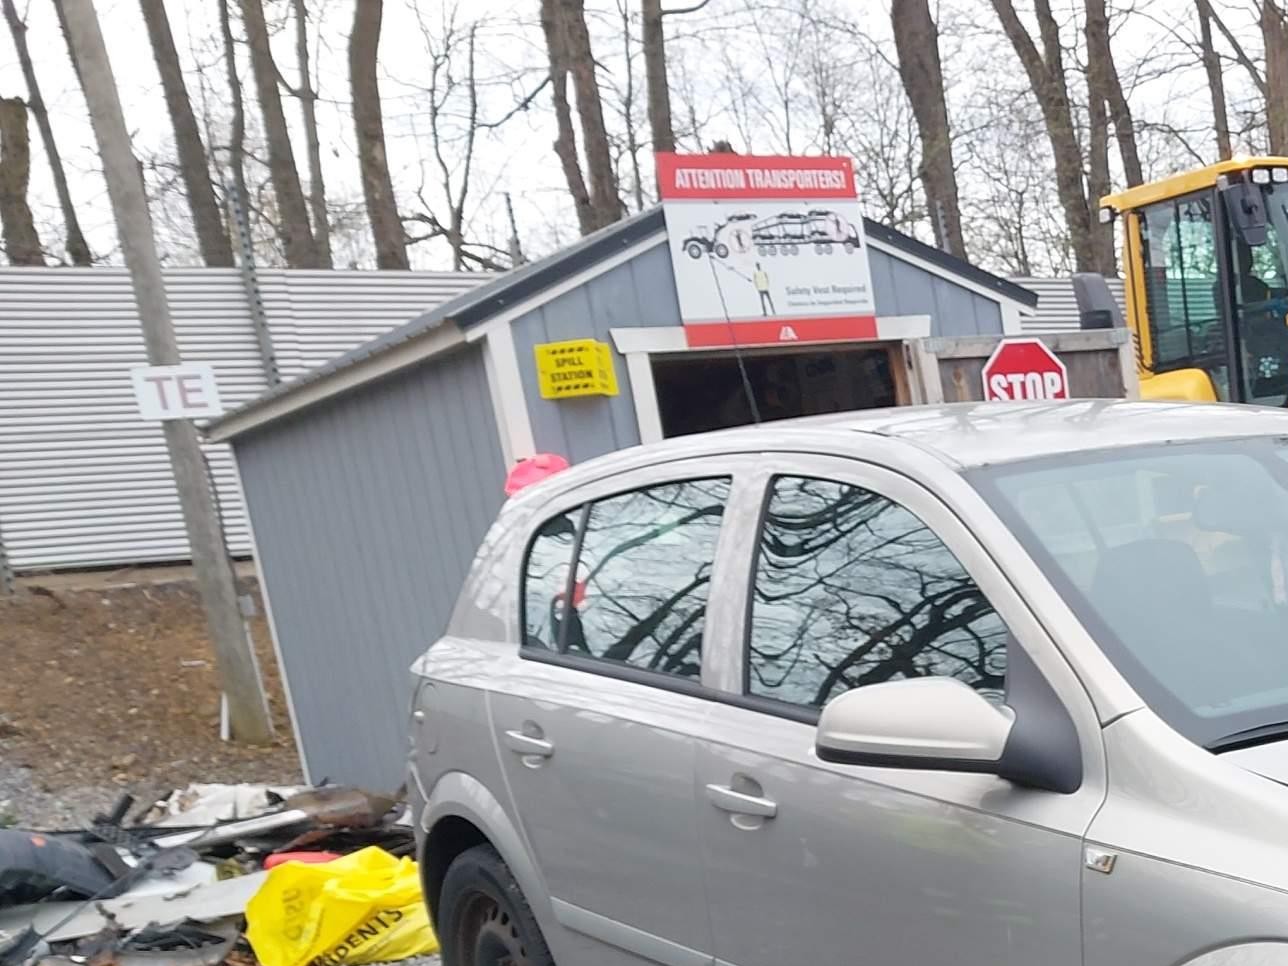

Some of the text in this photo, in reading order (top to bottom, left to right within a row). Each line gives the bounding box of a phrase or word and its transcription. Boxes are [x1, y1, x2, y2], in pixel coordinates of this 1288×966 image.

[675, 168, 847, 190] ATTENTION TRANSPORTERS!
[555, 357, 584, 368] SPILL
[550, 370, 594, 383] STATION
[989, 371, 1063, 401] STOP
[143, 374, 210, 410] TE
